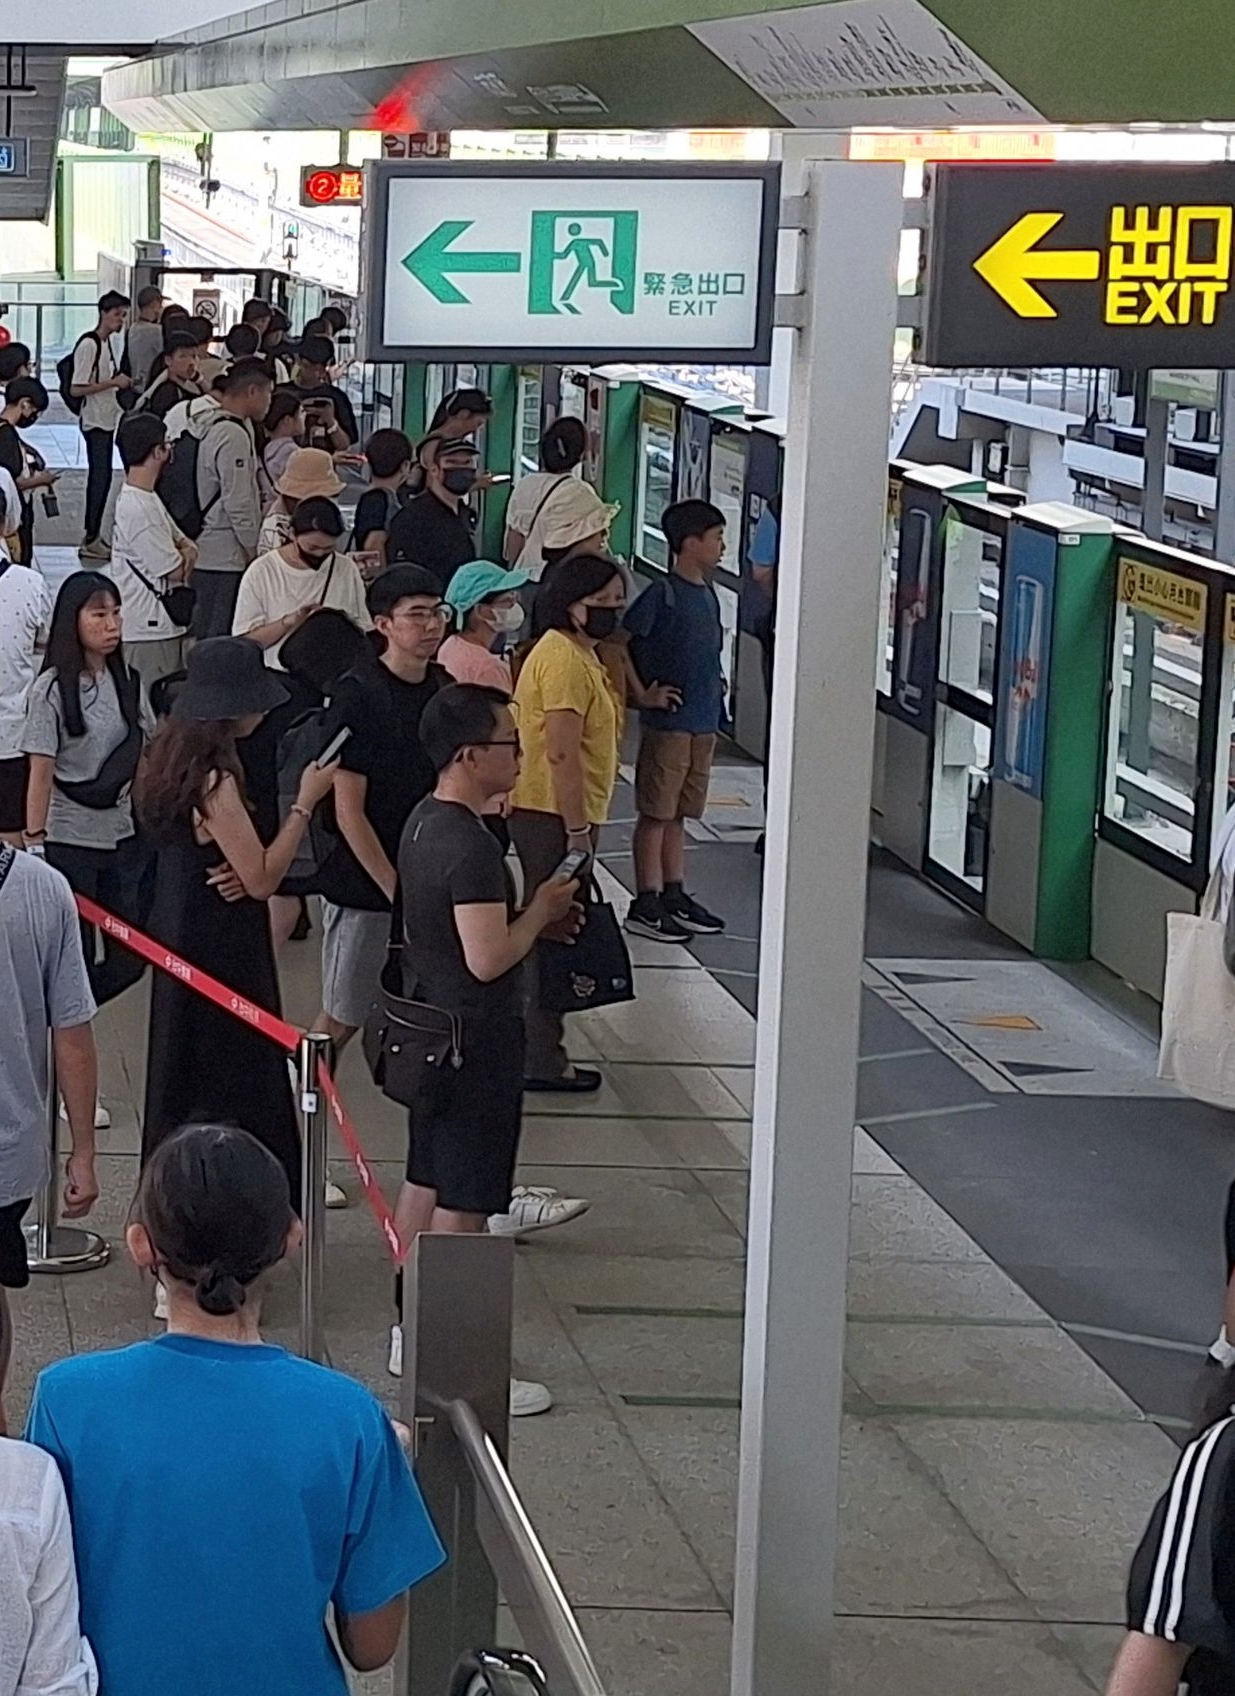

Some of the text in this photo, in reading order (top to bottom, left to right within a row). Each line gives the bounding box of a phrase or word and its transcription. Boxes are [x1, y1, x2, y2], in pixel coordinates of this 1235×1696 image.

[1109, 206, 1233, 280] 出口
[644, 272, 745, 295] 緊急出口
[669, 300, 718, 316] EXIT
[1105, 282, 1228, 324] EXIT
